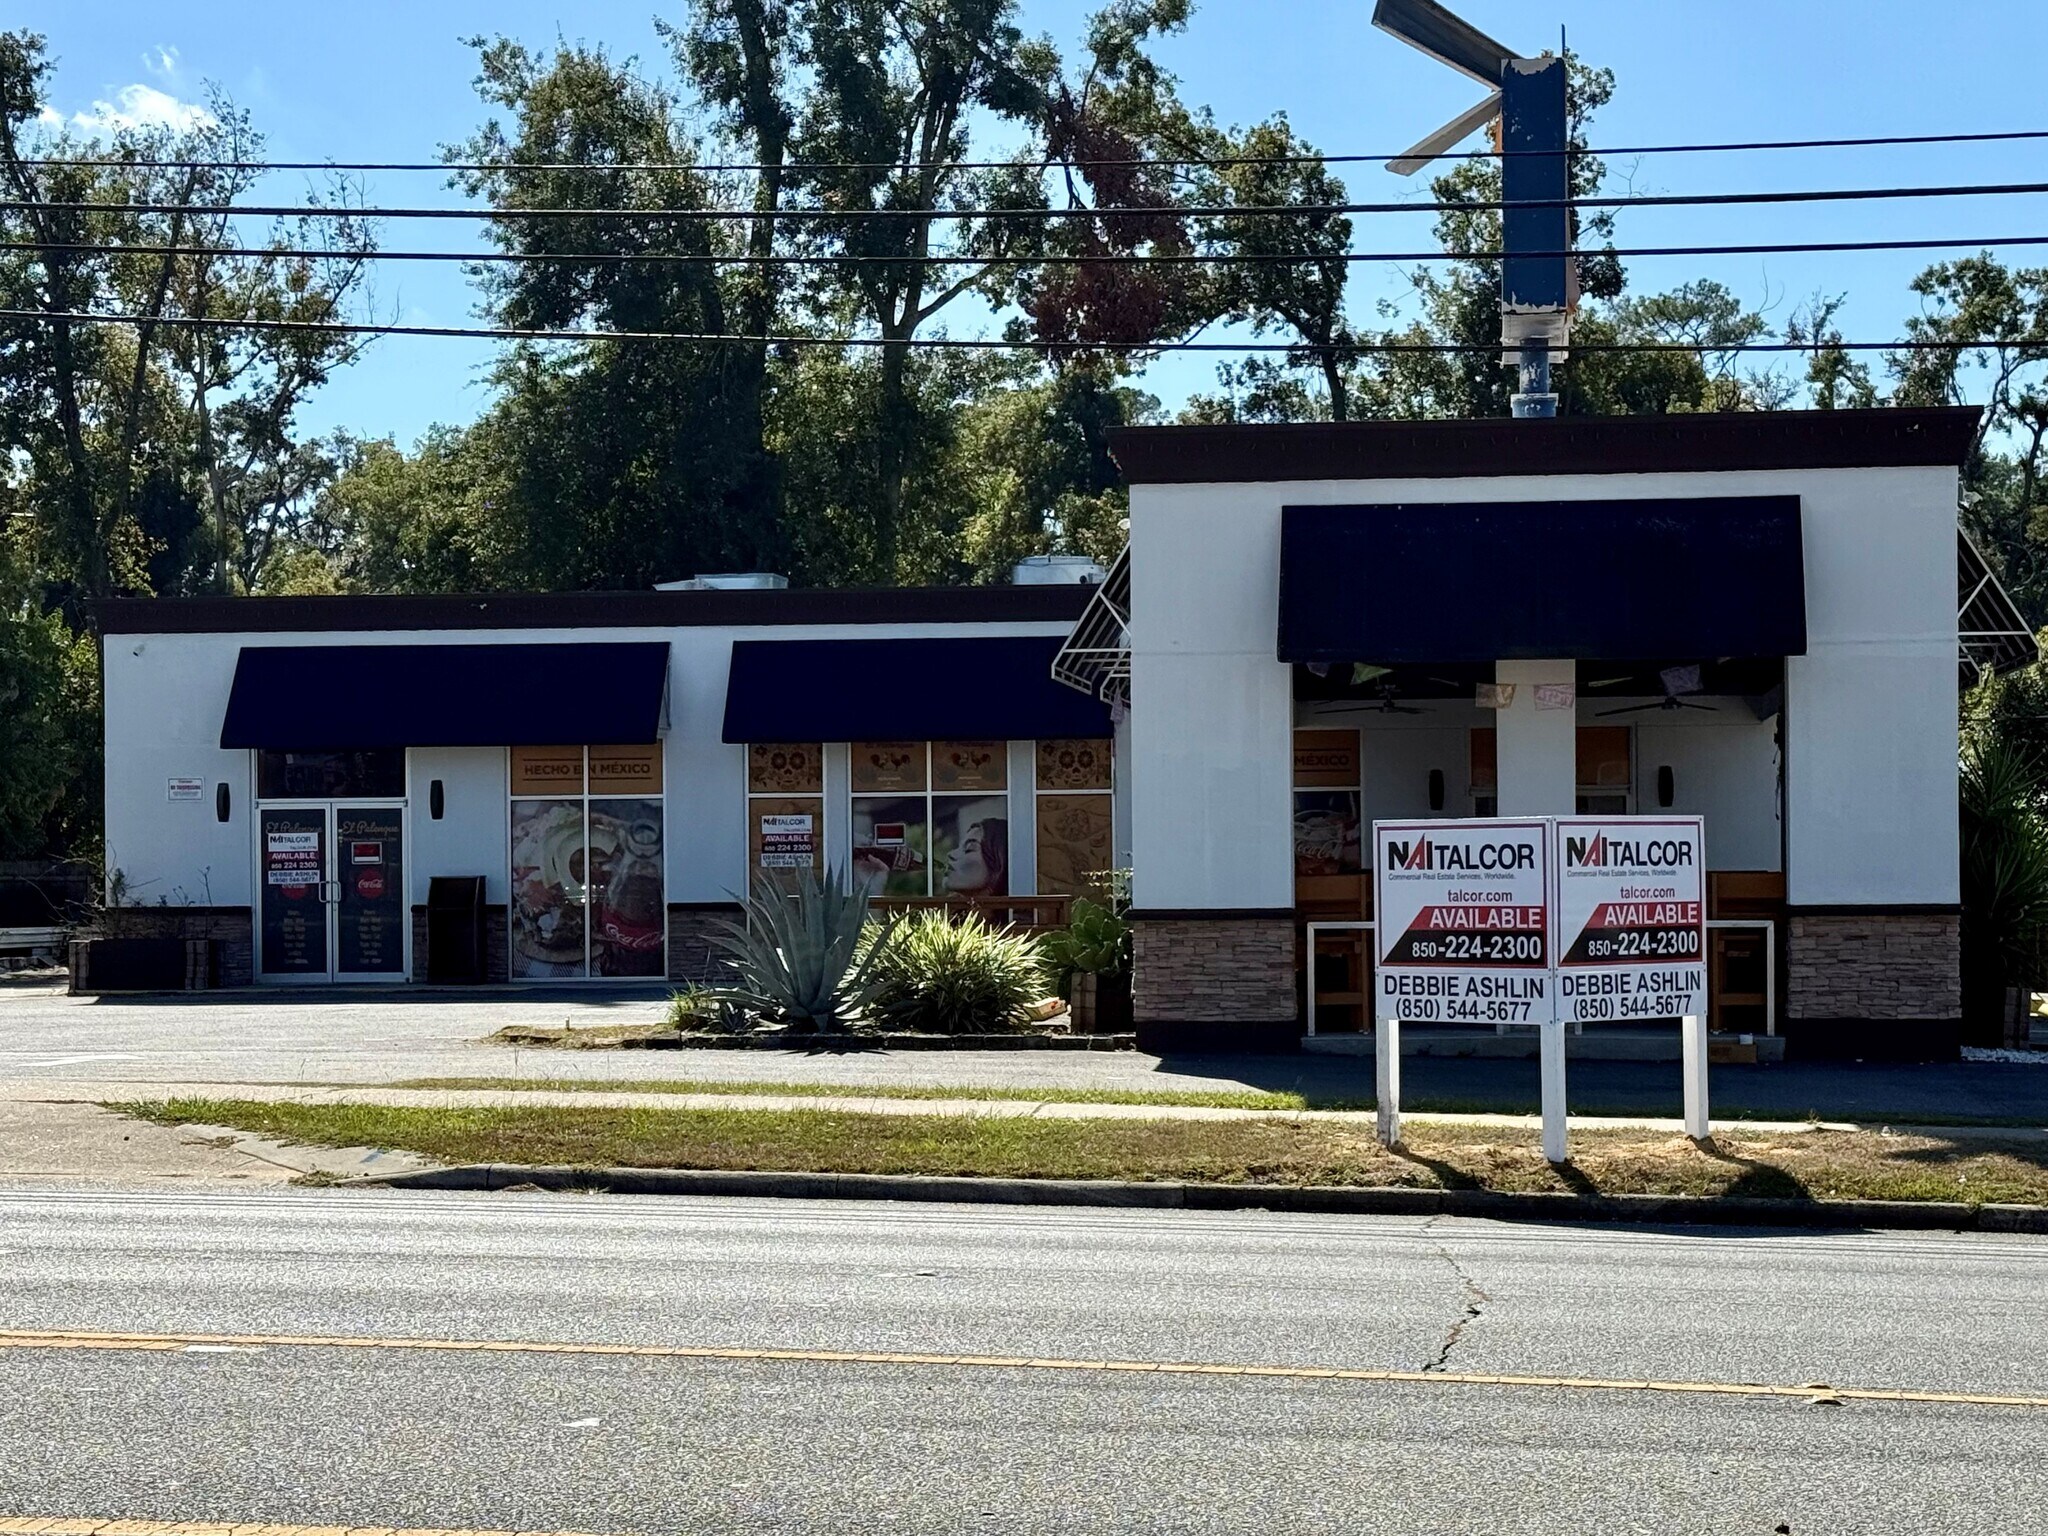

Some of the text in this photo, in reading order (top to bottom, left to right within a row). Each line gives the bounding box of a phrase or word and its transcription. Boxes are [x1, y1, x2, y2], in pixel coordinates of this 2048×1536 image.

[525, 764, 570, 775] HECHO
[600, 761, 650, 774] MÉXICO
[1294, 753, 1349, 766] MÉXICO
[765, 834, 810, 842] AVAILABLE
[272, 852, 316, 860] AVAILABLE
[283, 861, 297, 869] 224
[299, 861, 318, 869] 2300
[1388, 873, 1421, 881] Commercial
[1448, 889, 1513, 902] talcor.com
[1620, 886, 1676, 899] talcor.com
[1429, 907, 1542, 929] AVAILABLE
[1604, 903, 1698, 926] AVAILABLE
[1411, 935, 1543, 959] 850-224-2300
[1588, 930, 1699, 956] 850-224-2300
[1384, 975, 1545, 999] DEBBIE ASHLIN
[1562, 970, 1701, 996] DEBBIE ASHLIN
[1396, 998, 1532, 1021] (850) 544-5677
[1574, 994, 1692, 1021] (850) 544-5677
